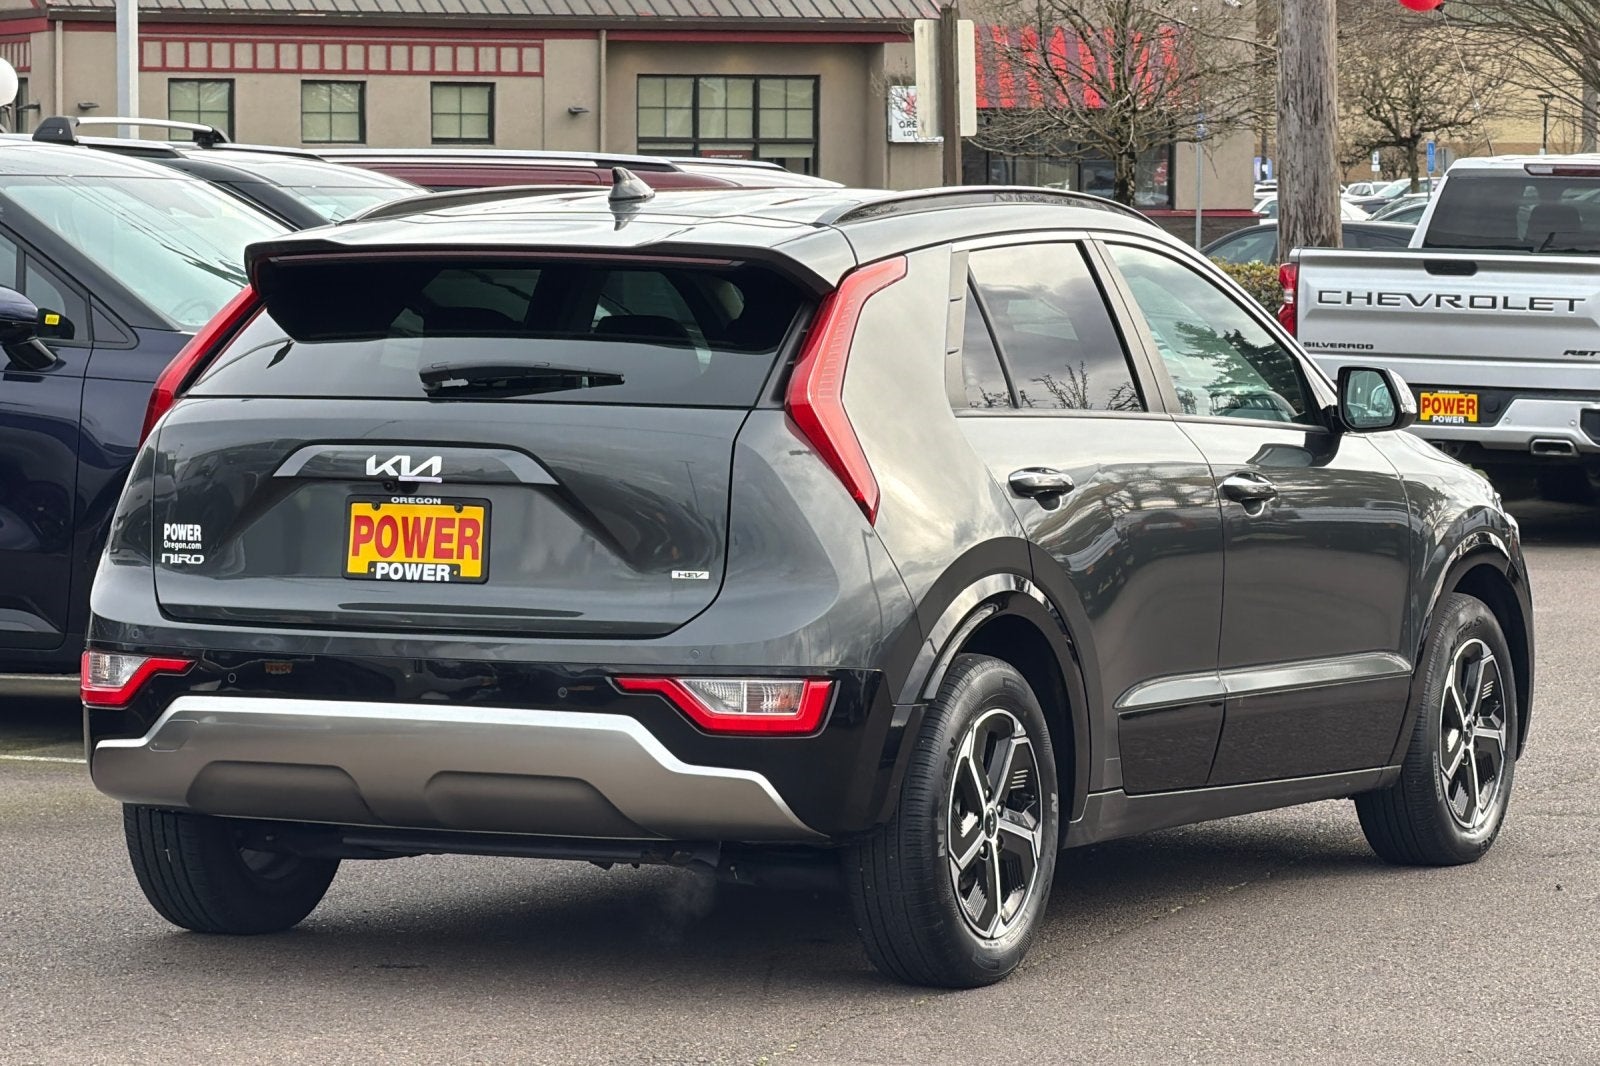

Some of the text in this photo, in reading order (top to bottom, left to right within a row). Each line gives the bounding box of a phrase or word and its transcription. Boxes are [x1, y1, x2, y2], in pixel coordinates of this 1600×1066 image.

[899, 120, 917, 128] ORE
[1318, 290, 1586, 312] CHEVROLET
[1303, 341, 1374, 350] SILVERADO
[1421, 397, 1476, 415] POWER
[1432, 415, 1465, 424] POWER
[366, 454, 443, 477] KIA
[391, 496, 442, 505] OREGON
[163, 523, 202, 541] POWER
[351, 514, 481, 560] POWER
[163, 540, 202, 550] Oregon.com
[161, 553, 205, 564] NIRO
[375, 562, 451, 582] POWER
